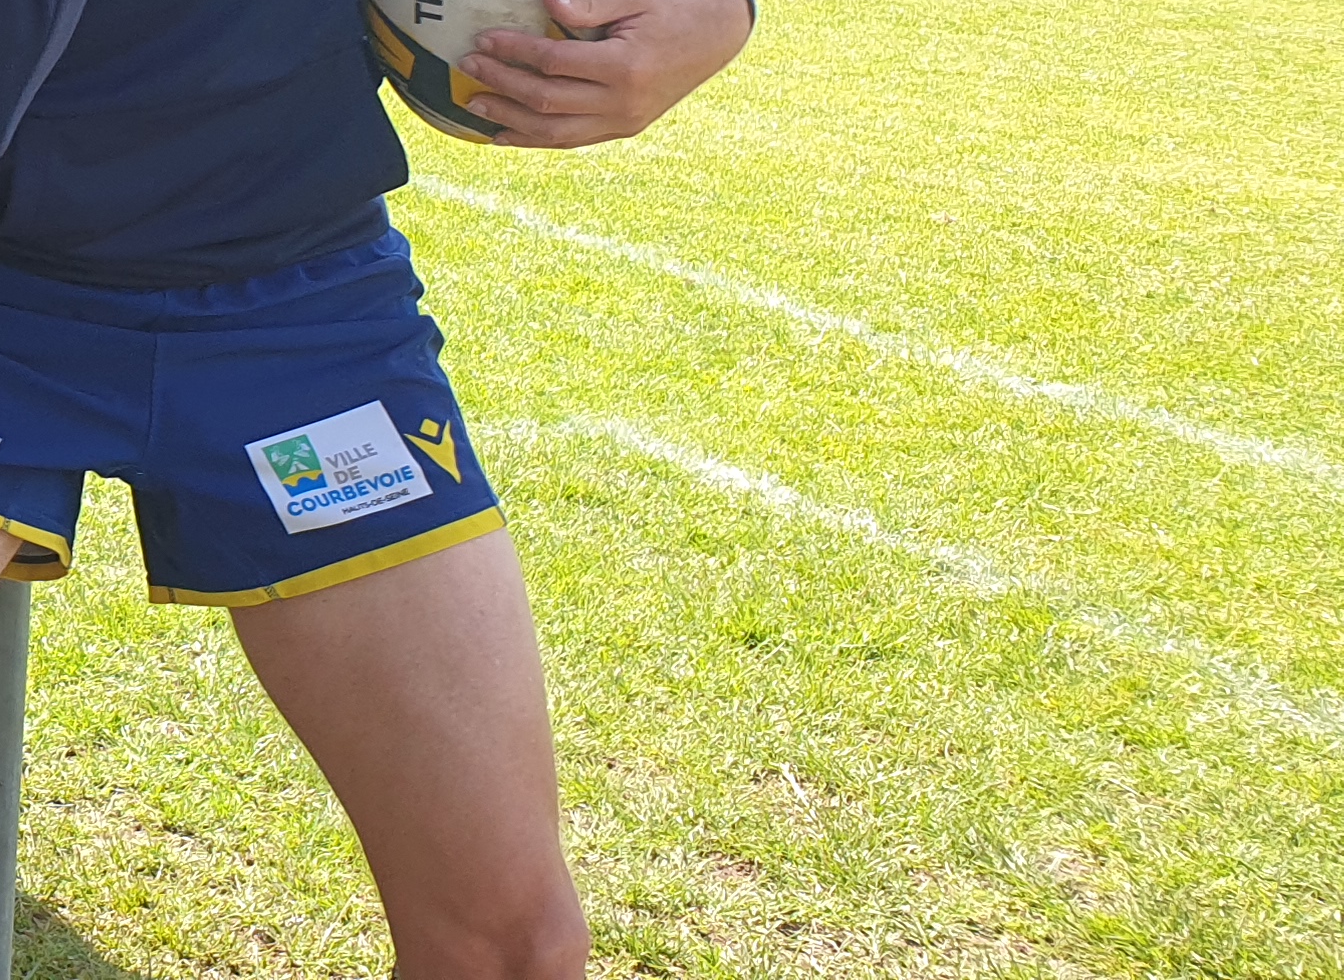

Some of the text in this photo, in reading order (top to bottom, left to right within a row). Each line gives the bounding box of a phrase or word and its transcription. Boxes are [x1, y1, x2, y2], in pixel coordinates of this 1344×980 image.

[325, 442, 378, 469] VILLE
[333, 465, 362, 485] DE
[287, 465, 414, 517] COURBEVOIE
